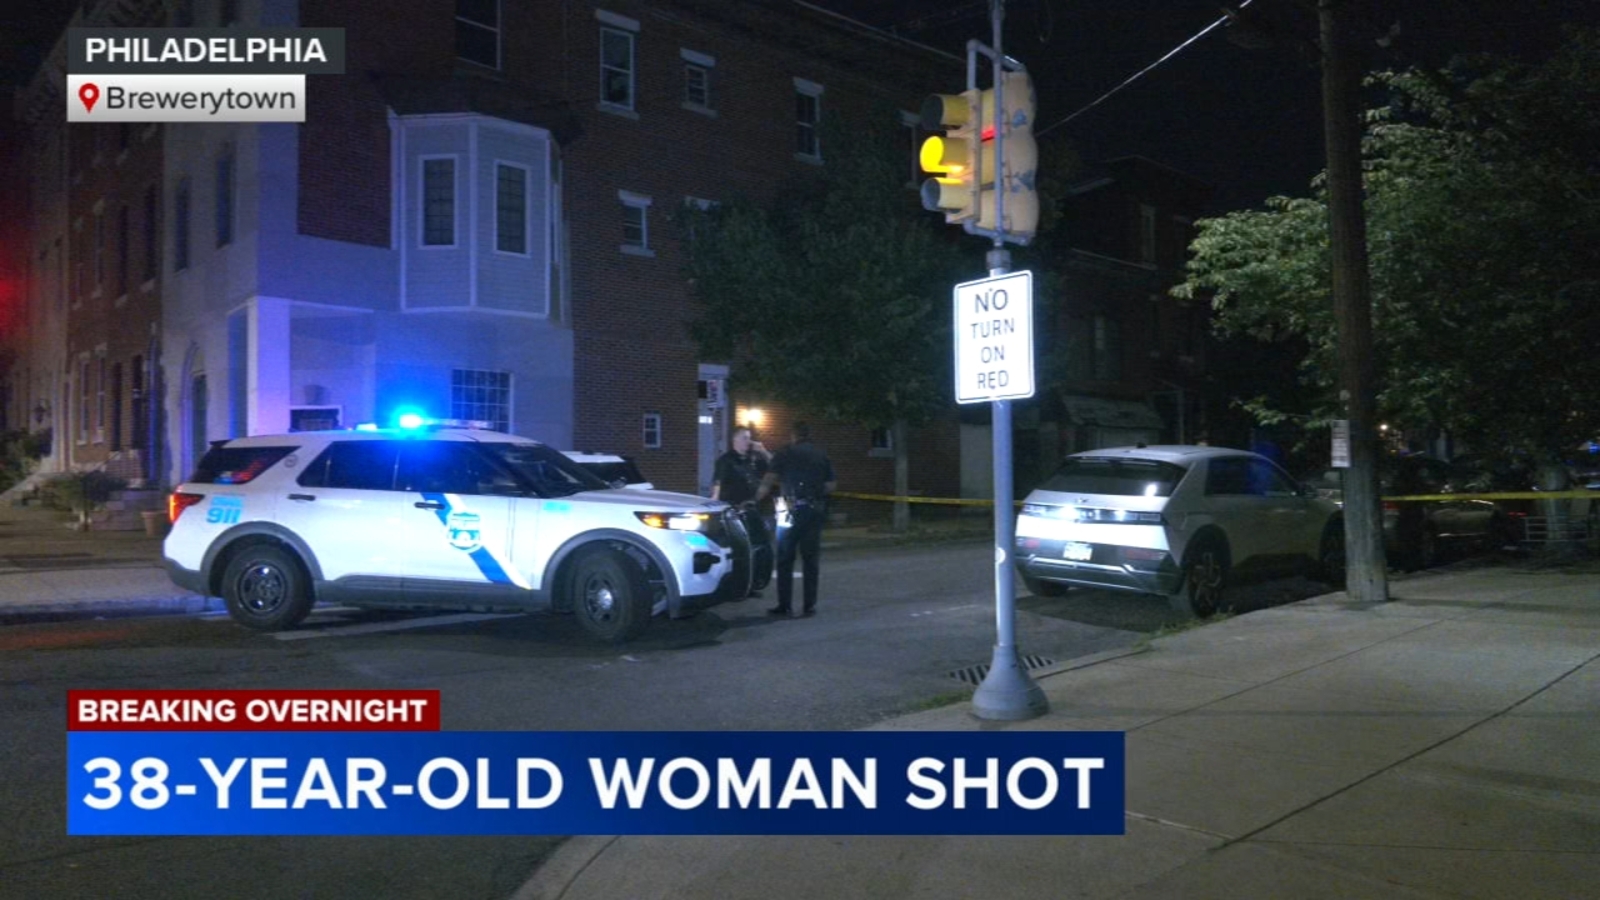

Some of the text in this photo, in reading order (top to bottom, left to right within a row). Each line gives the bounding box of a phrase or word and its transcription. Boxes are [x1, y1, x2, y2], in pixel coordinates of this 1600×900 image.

[975, 289, 1009, 313] NO
[971, 318, 1015, 339] TURN
[981, 345, 1005, 364] ON
[977, 370, 1009, 390] RED
[206, 507, 241, 523] 911
